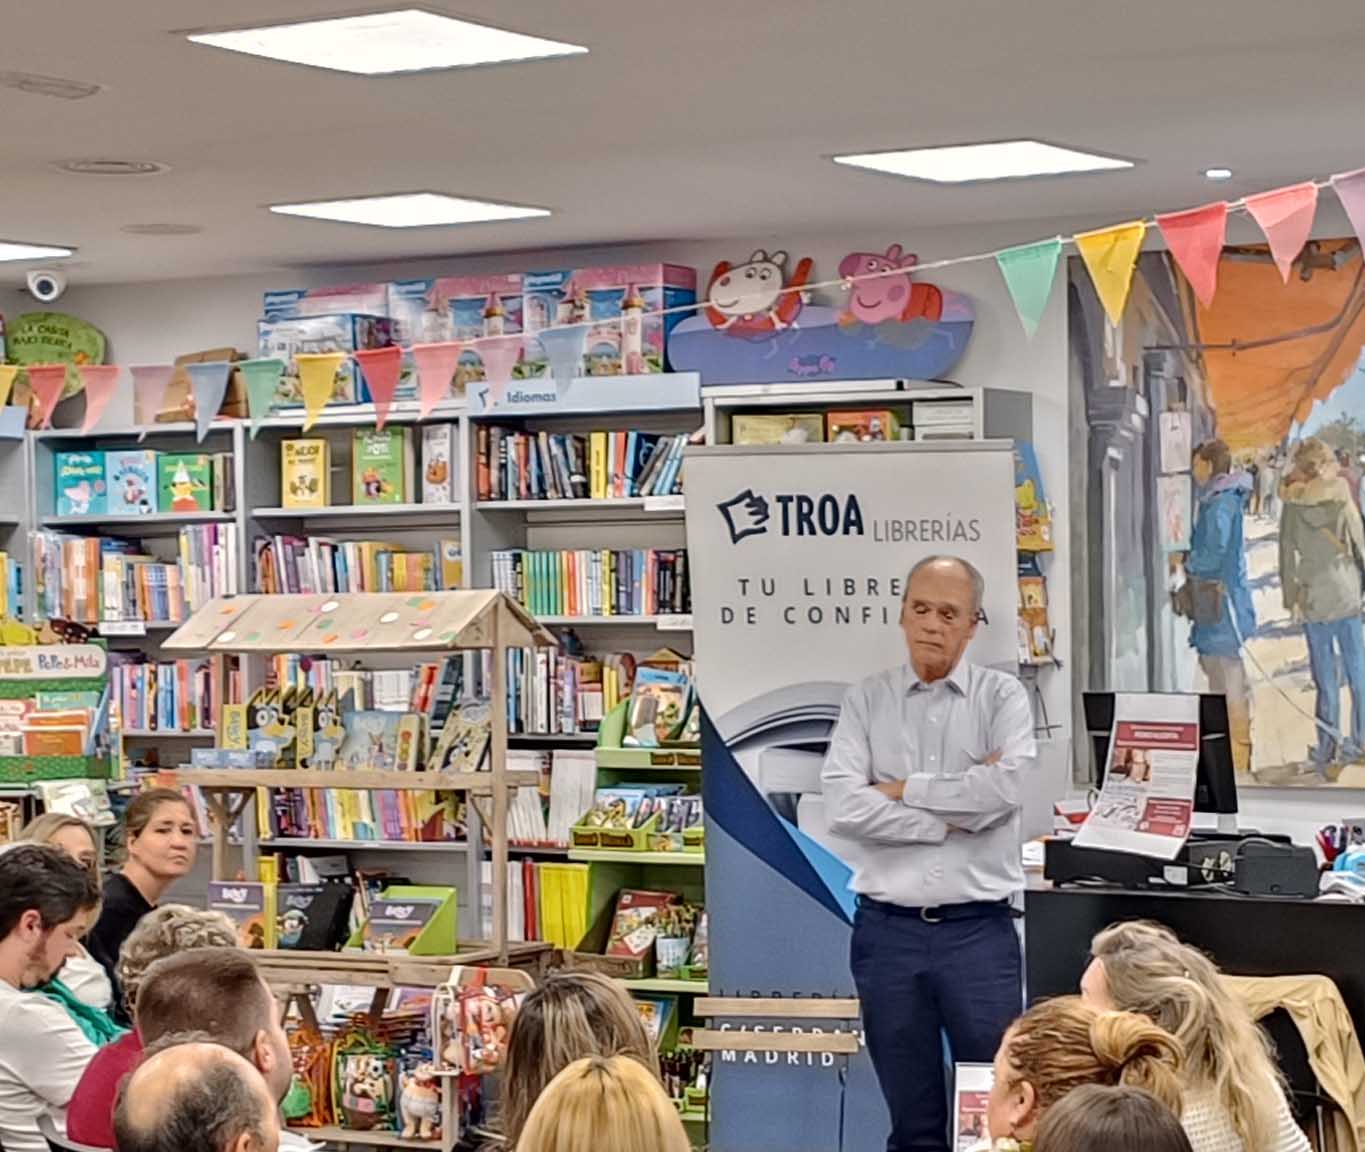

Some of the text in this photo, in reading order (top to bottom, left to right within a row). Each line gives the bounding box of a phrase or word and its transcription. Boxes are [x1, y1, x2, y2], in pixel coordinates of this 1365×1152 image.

[506, 389, 557, 404] Idiomas
[775, 493, 982, 543] TROA LIBRERÍAS
[737, 577, 901, 597] TU LIBRE
[720, 606, 989, 625] DE CONFIA
[721, 1049, 835, 1067] MADRID
